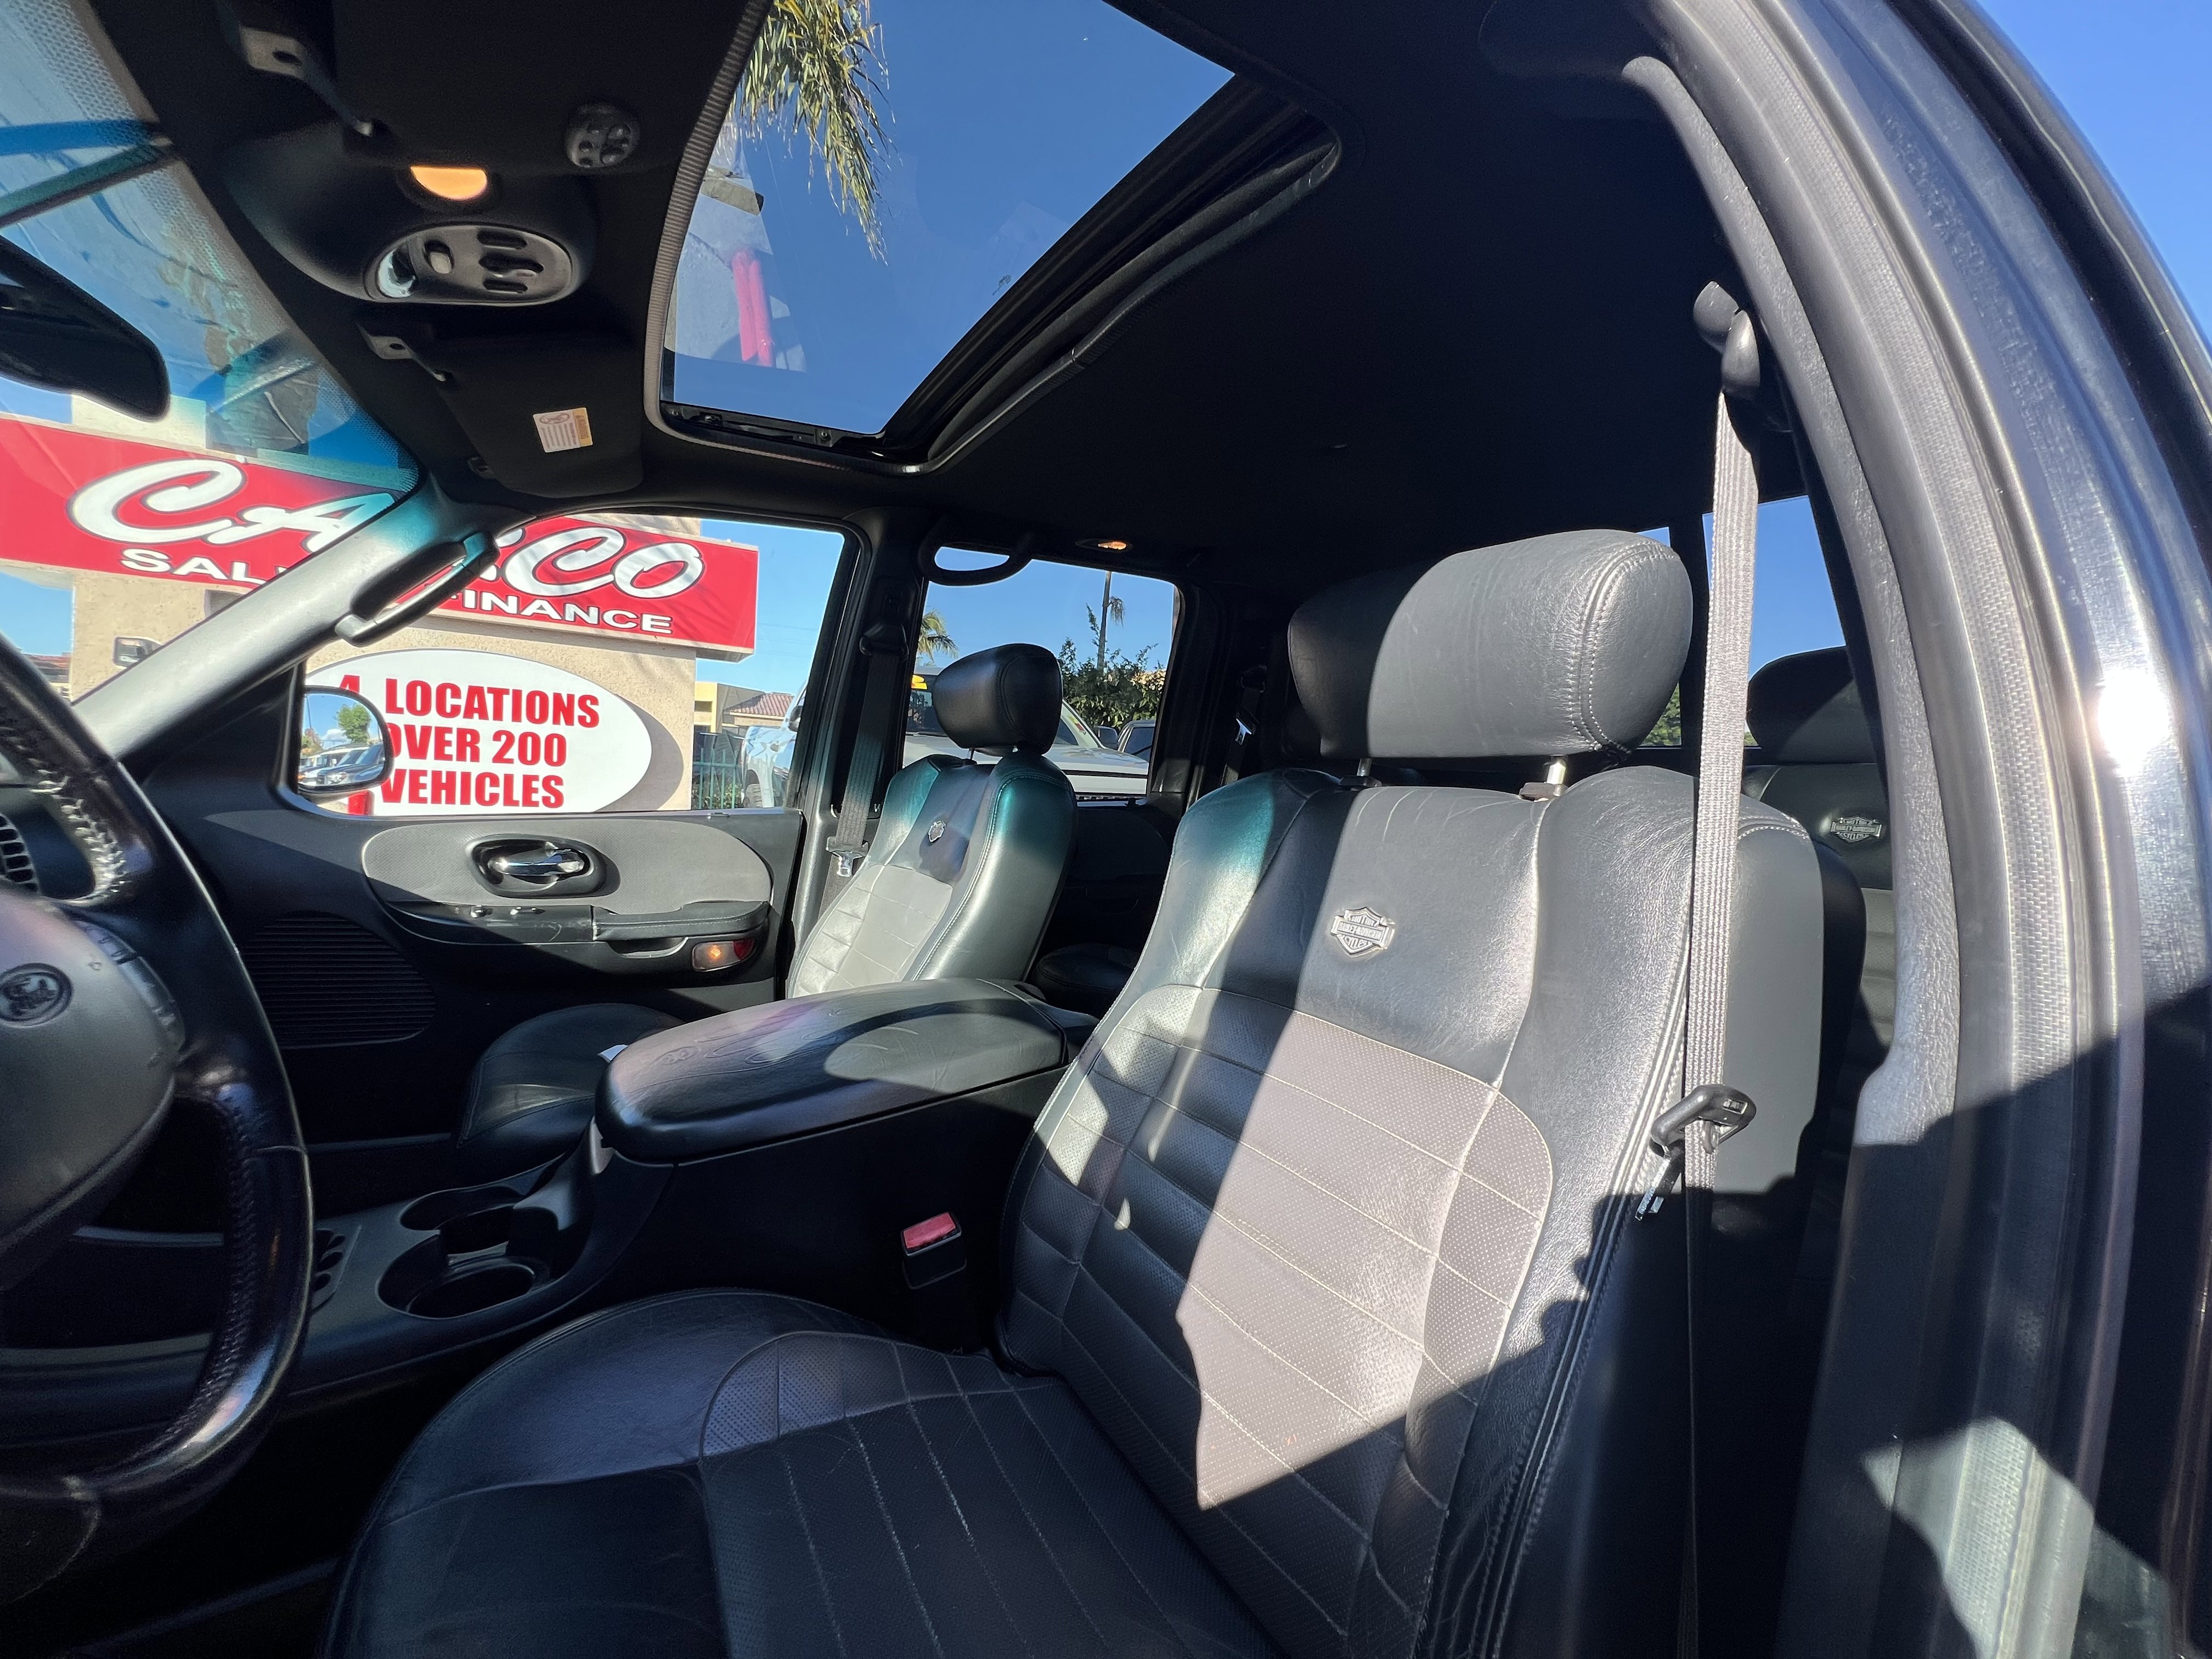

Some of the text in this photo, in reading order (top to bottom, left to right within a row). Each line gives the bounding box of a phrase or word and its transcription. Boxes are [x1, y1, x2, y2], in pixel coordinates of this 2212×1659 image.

[68, 459, 704, 599] CACO
[119, 548, 673, 634] SAL INANCE
[385, 678, 600, 728] LOCATIONS
[492, 730, 567, 767] 200
[380, 768, 565, 809] VEHICLES
